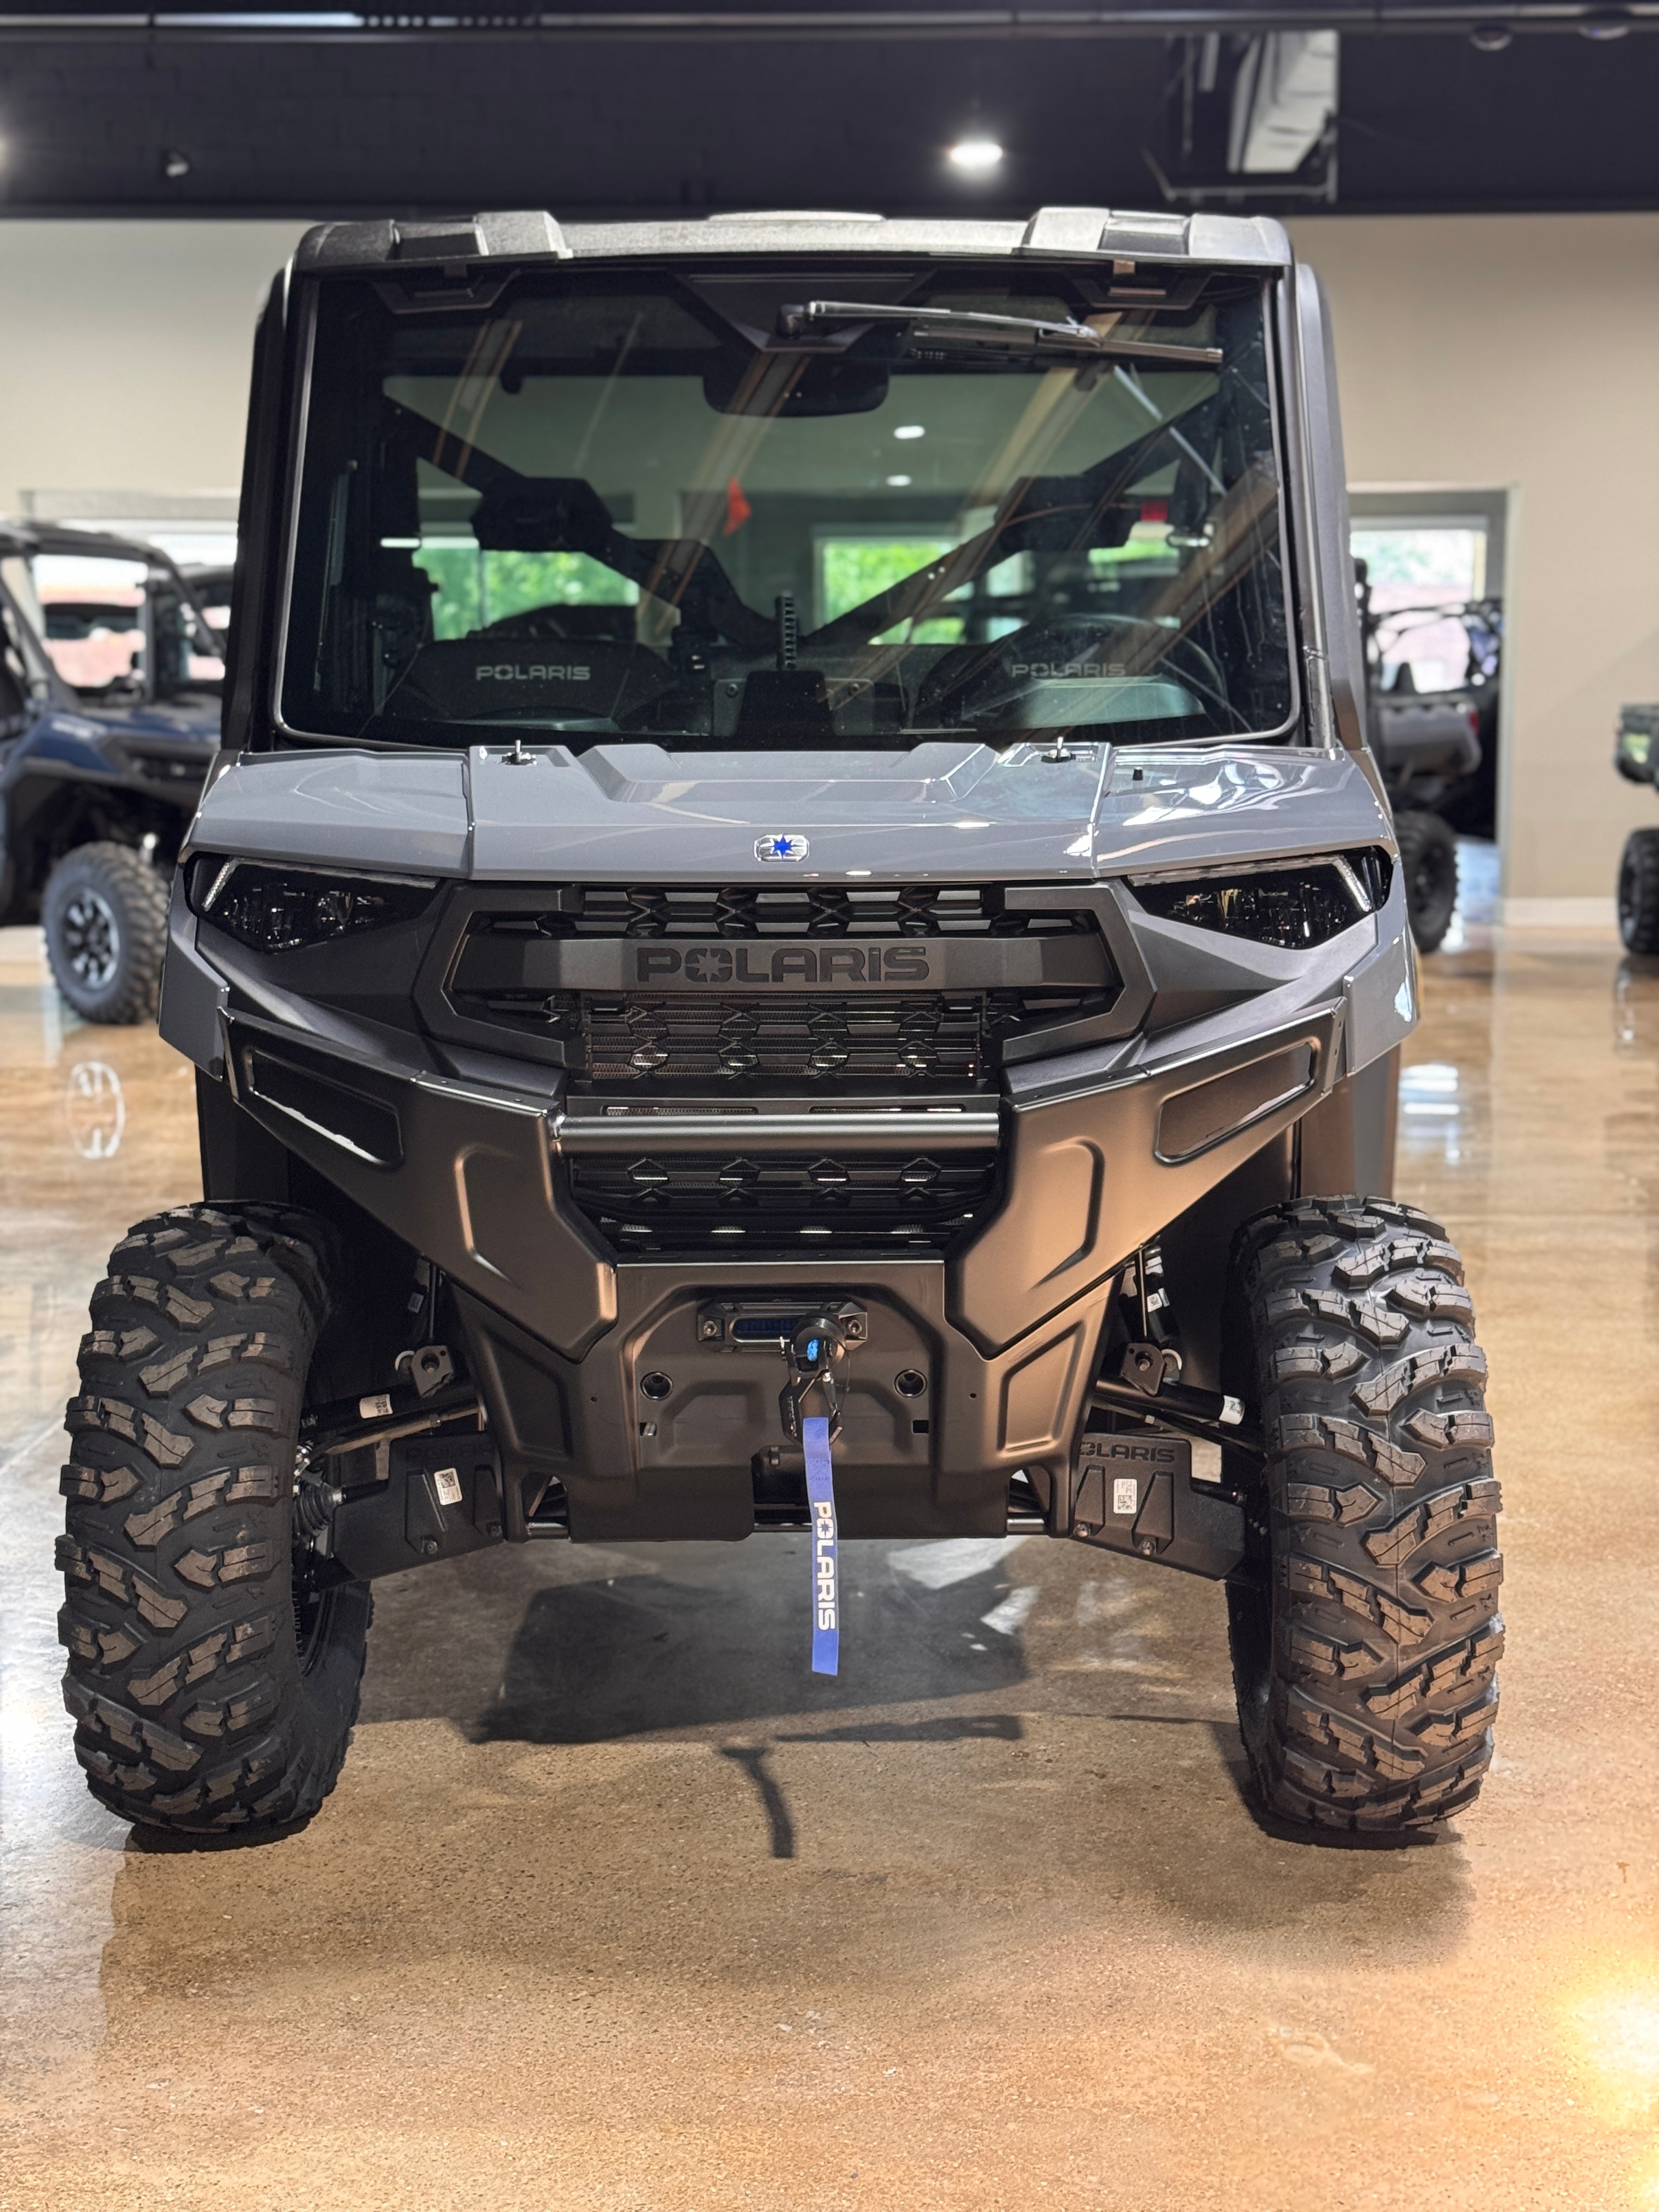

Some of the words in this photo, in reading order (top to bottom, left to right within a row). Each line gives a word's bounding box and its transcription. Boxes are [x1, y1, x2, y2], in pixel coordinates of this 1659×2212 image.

[476, 664, 591, 680] POLARIS
[1012, 663, 1125, 678] POLARIS
[637, 947, 929, 983] POLARIS
[1079, 1441, 1175, 1463] OLARIS
[814, 1502, 836, 1630] POLARIS
